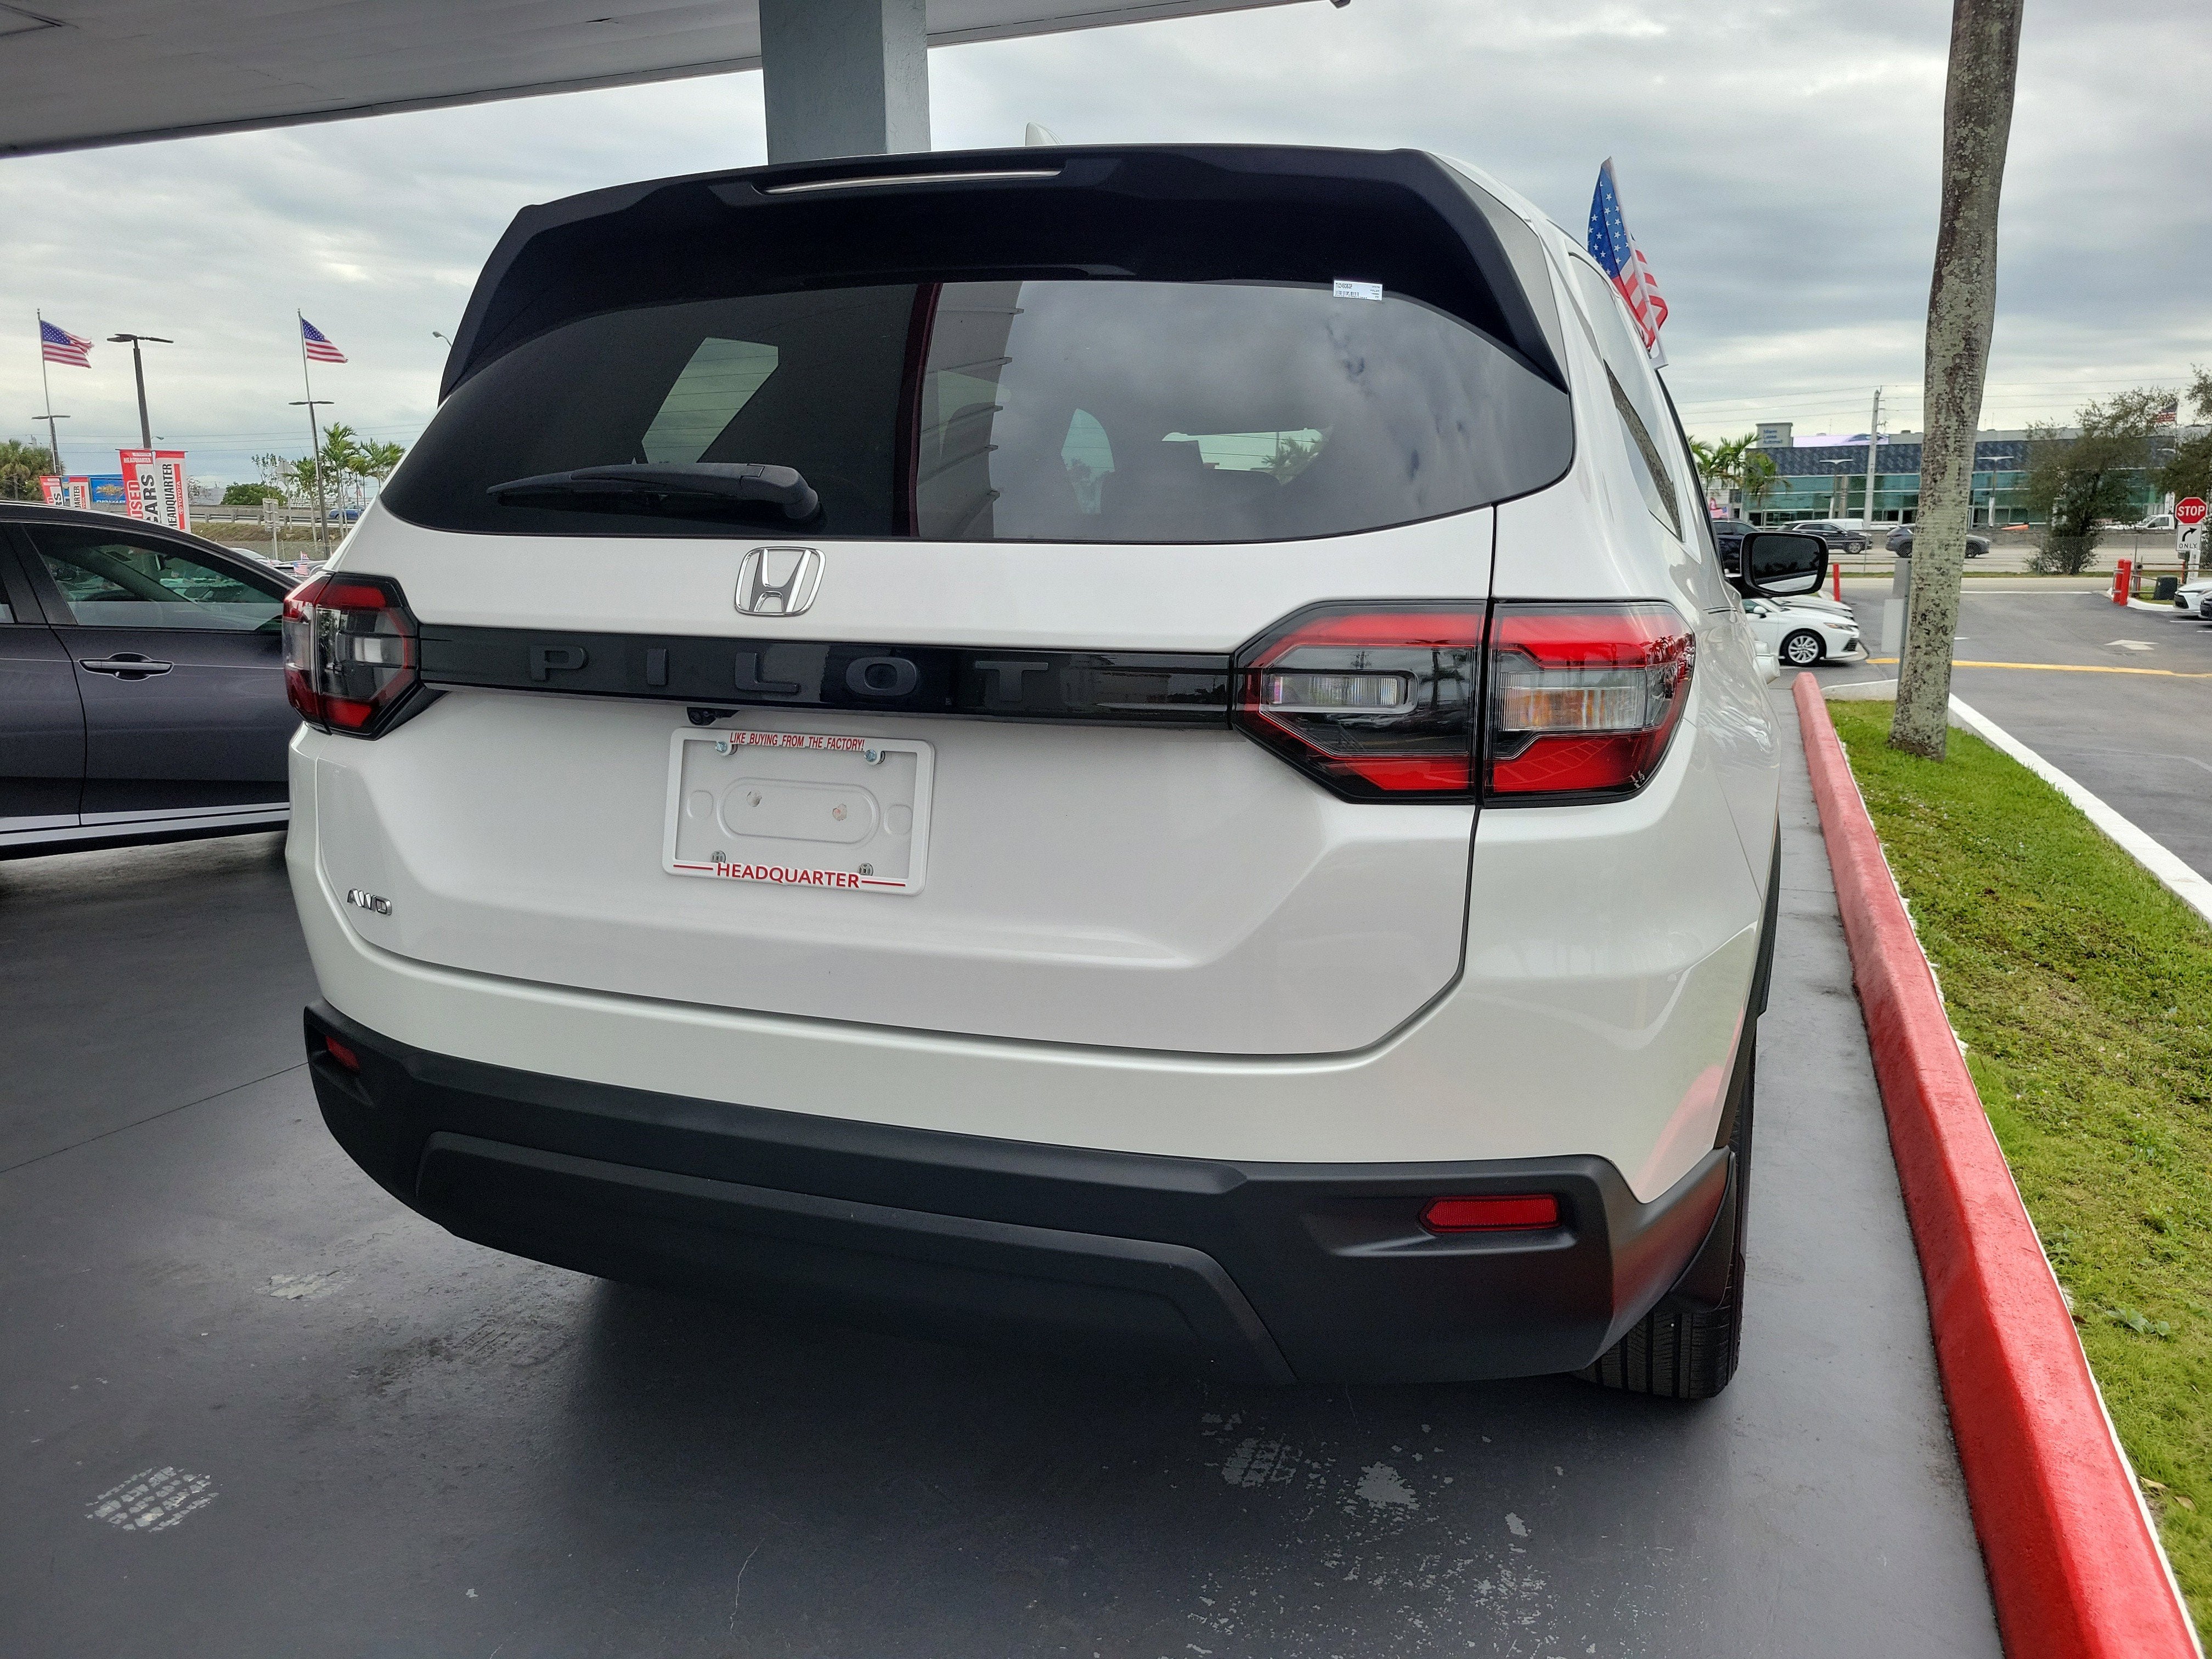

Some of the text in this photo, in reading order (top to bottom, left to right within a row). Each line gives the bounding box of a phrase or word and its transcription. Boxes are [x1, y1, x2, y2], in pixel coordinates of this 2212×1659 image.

[2177, 505, 2205, 517] STOP
[530, 644, 1049, 703] PILOT
[730, 732, 865, 751] LIKE BUYING FROM THE FACTORY!
[717, 863, 859, 888] HEADQUARTER
[347, 888, 392, 916] AWD
